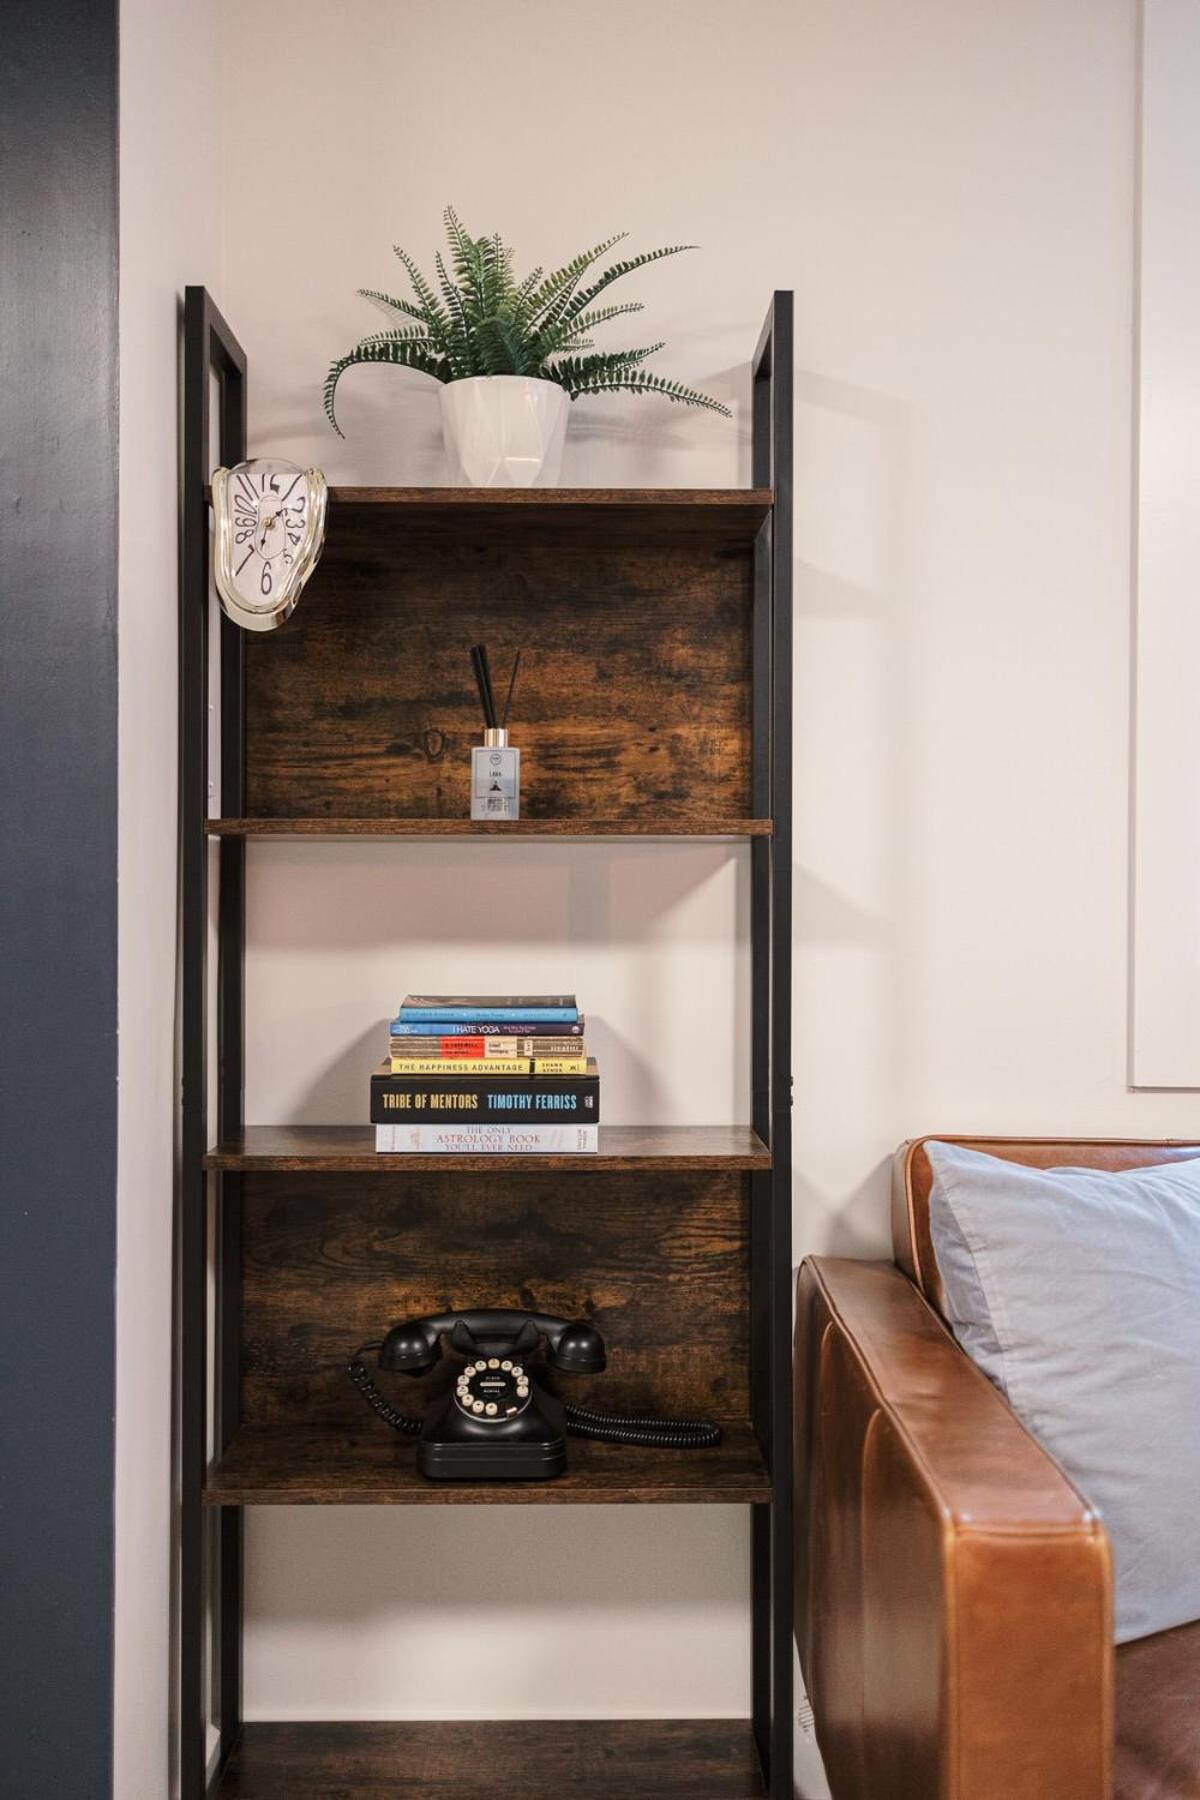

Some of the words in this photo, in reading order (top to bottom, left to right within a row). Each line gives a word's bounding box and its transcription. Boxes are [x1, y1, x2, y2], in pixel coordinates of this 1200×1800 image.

[235, 529, 254, 544] 8
[235, 544, 255, 577] 7
[260, 561, 272, 595] 6
[399, 1063, 416, 1071] THE
[419, 1063, 469, 1071] HAPPINESS
[383, 1093, 412, 1109] TRIBE
[414, 1093, 427, 1109] OF
[430, 1093, 479, 1109] MENTORS
[487, 1094, 533, 1110] TIMOTHY
[535, 1094, 577, 1110] FERRISS
[509, 1134, 541, 1144] BOOK
